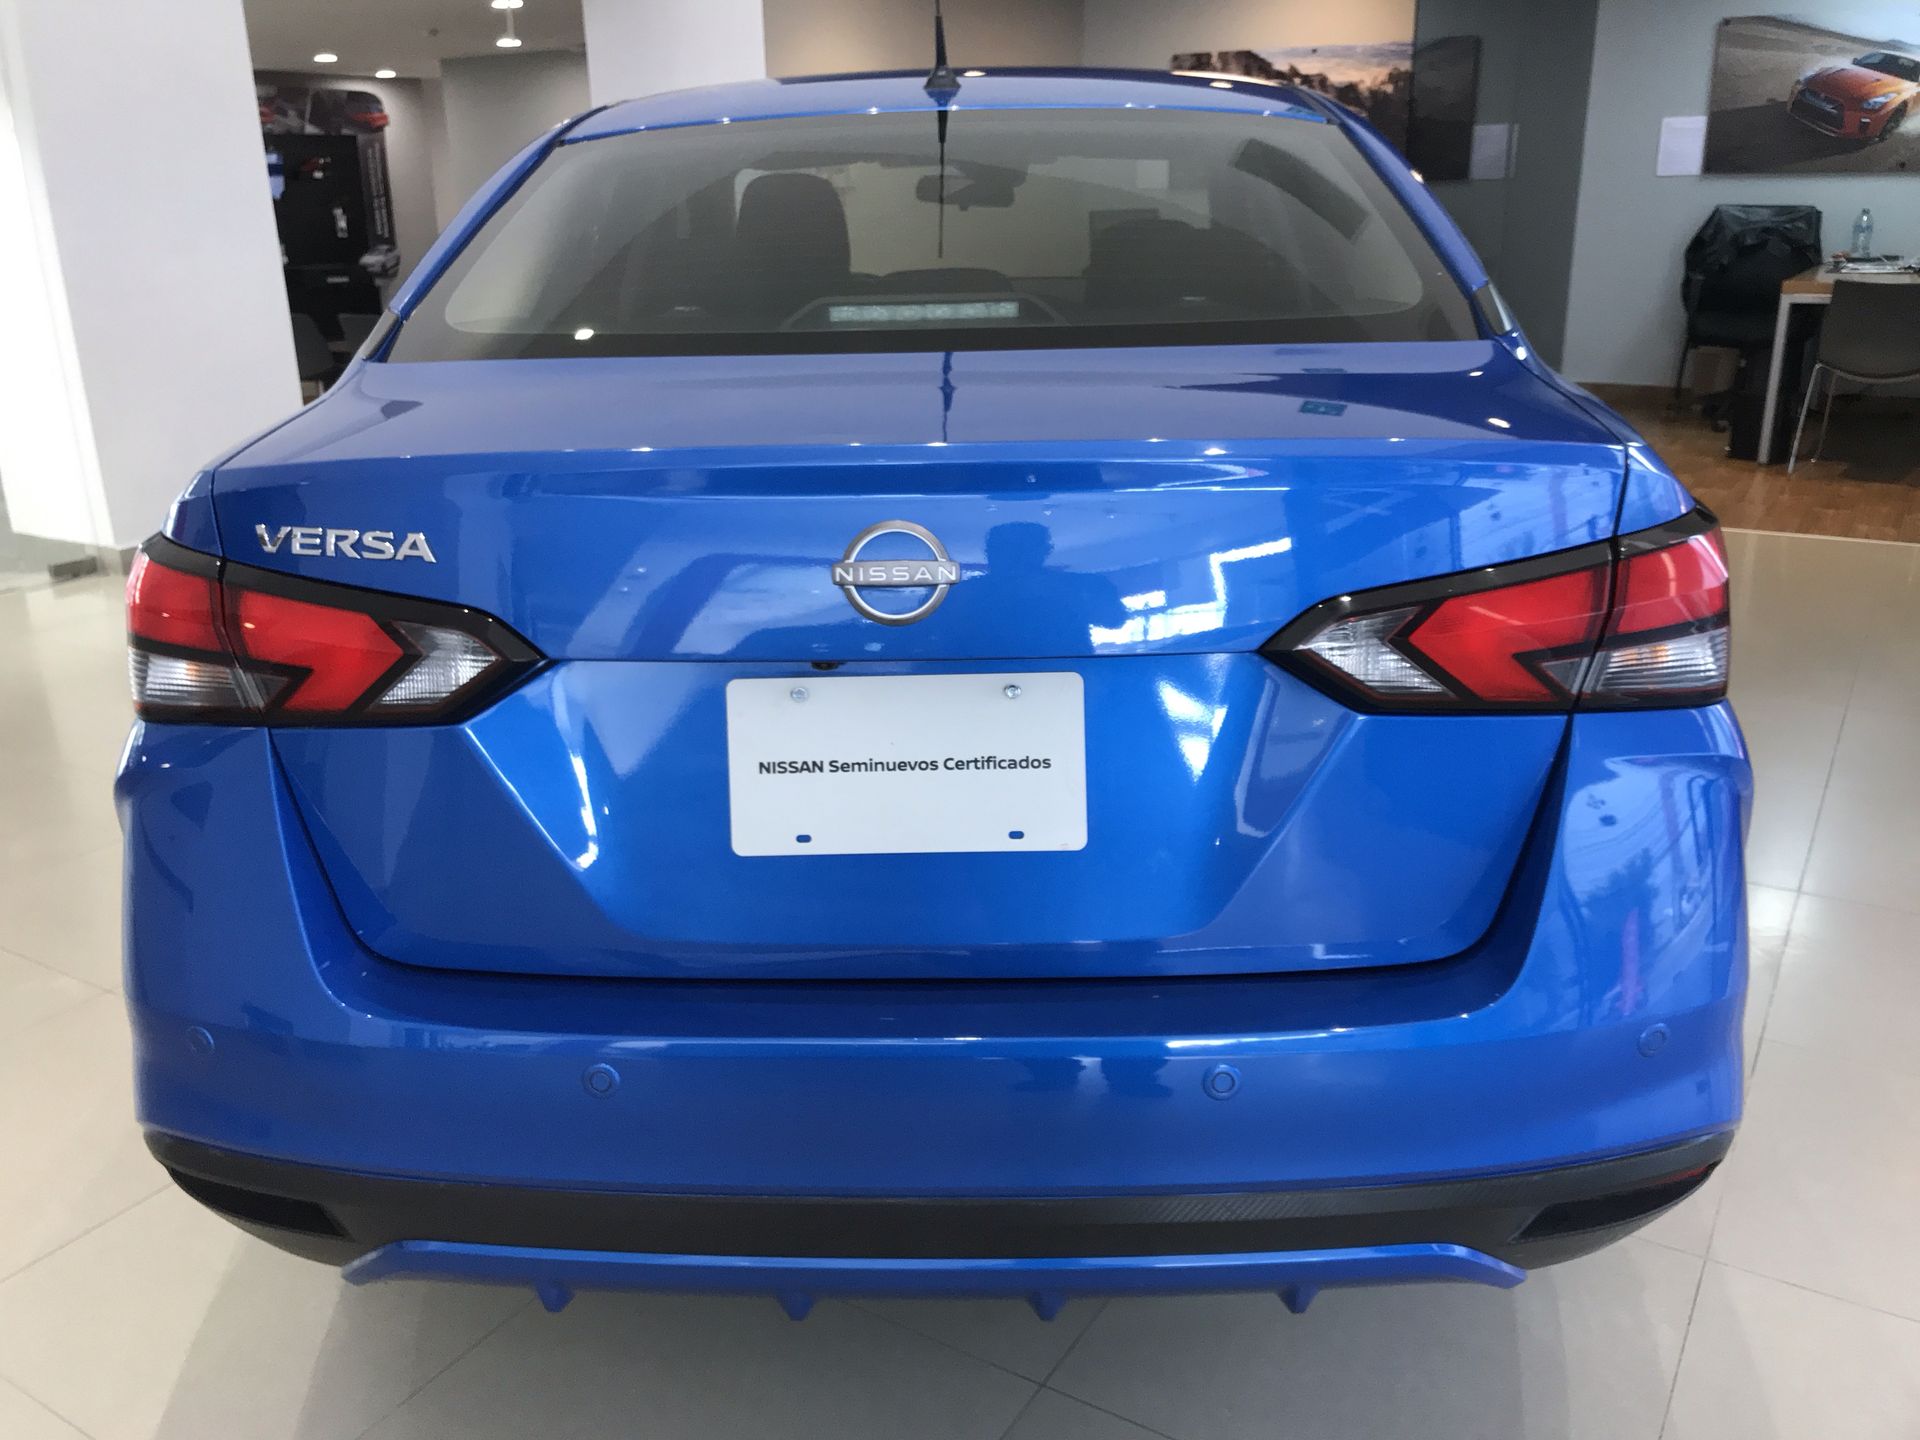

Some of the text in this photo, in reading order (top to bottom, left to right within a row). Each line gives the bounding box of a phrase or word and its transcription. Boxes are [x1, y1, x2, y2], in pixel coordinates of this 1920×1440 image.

[255, 523, 437, 563] VERSA
[835, 566, 957, 582] NISSAN
[758, 755, 1052, 774] NISSAN Seminuevos Certificados
